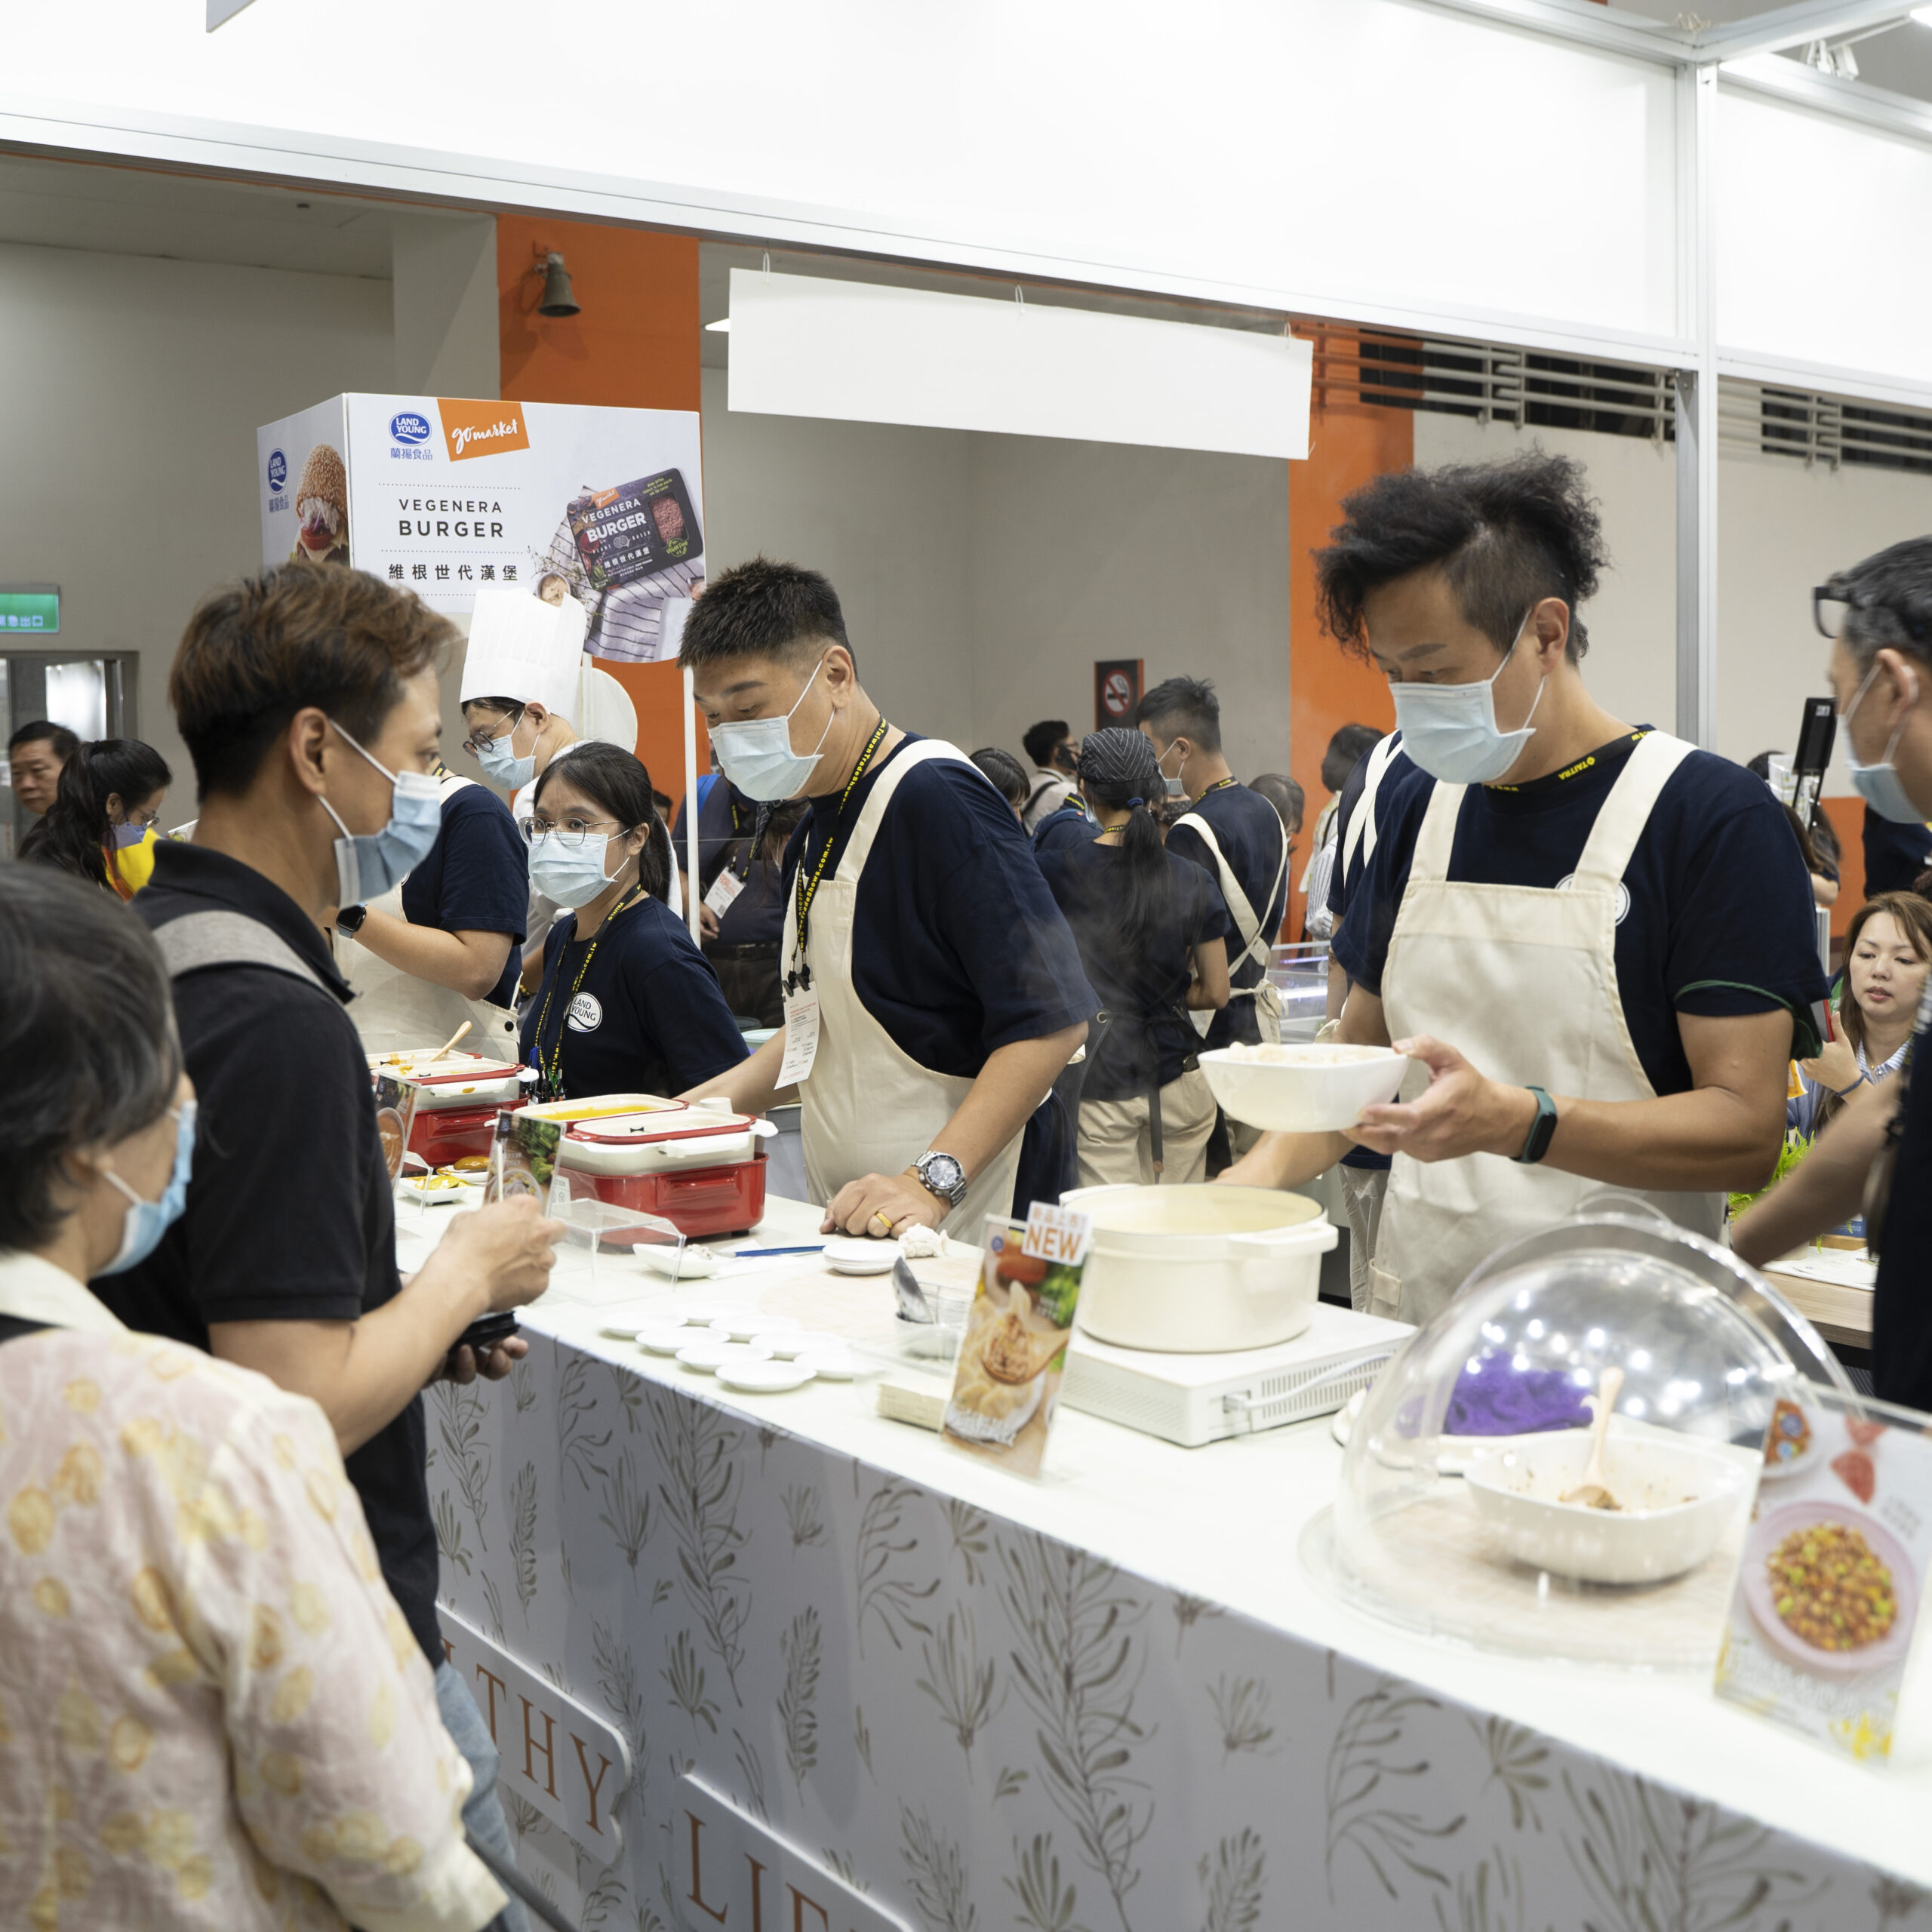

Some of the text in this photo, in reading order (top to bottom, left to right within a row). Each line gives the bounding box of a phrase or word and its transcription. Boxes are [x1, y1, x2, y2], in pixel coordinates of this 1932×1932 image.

[396, 417, 420, 426] LAND
[396, 424, 426, 434] YOUNG
[398, 499, 502, 513] VEGENERA
[582, 498, 641, 524] VEGENERA
[398, 520, 503, 538] BURGER
[586, 512, 647, 543] BURGER
[389, 564, 518, 581] 維根世代漢堡
[574, 997, 592, 1010] LAND
[571, 1004, 596, 1022] YOUNG
[1026, 1224, 1082, 1261] NEW
